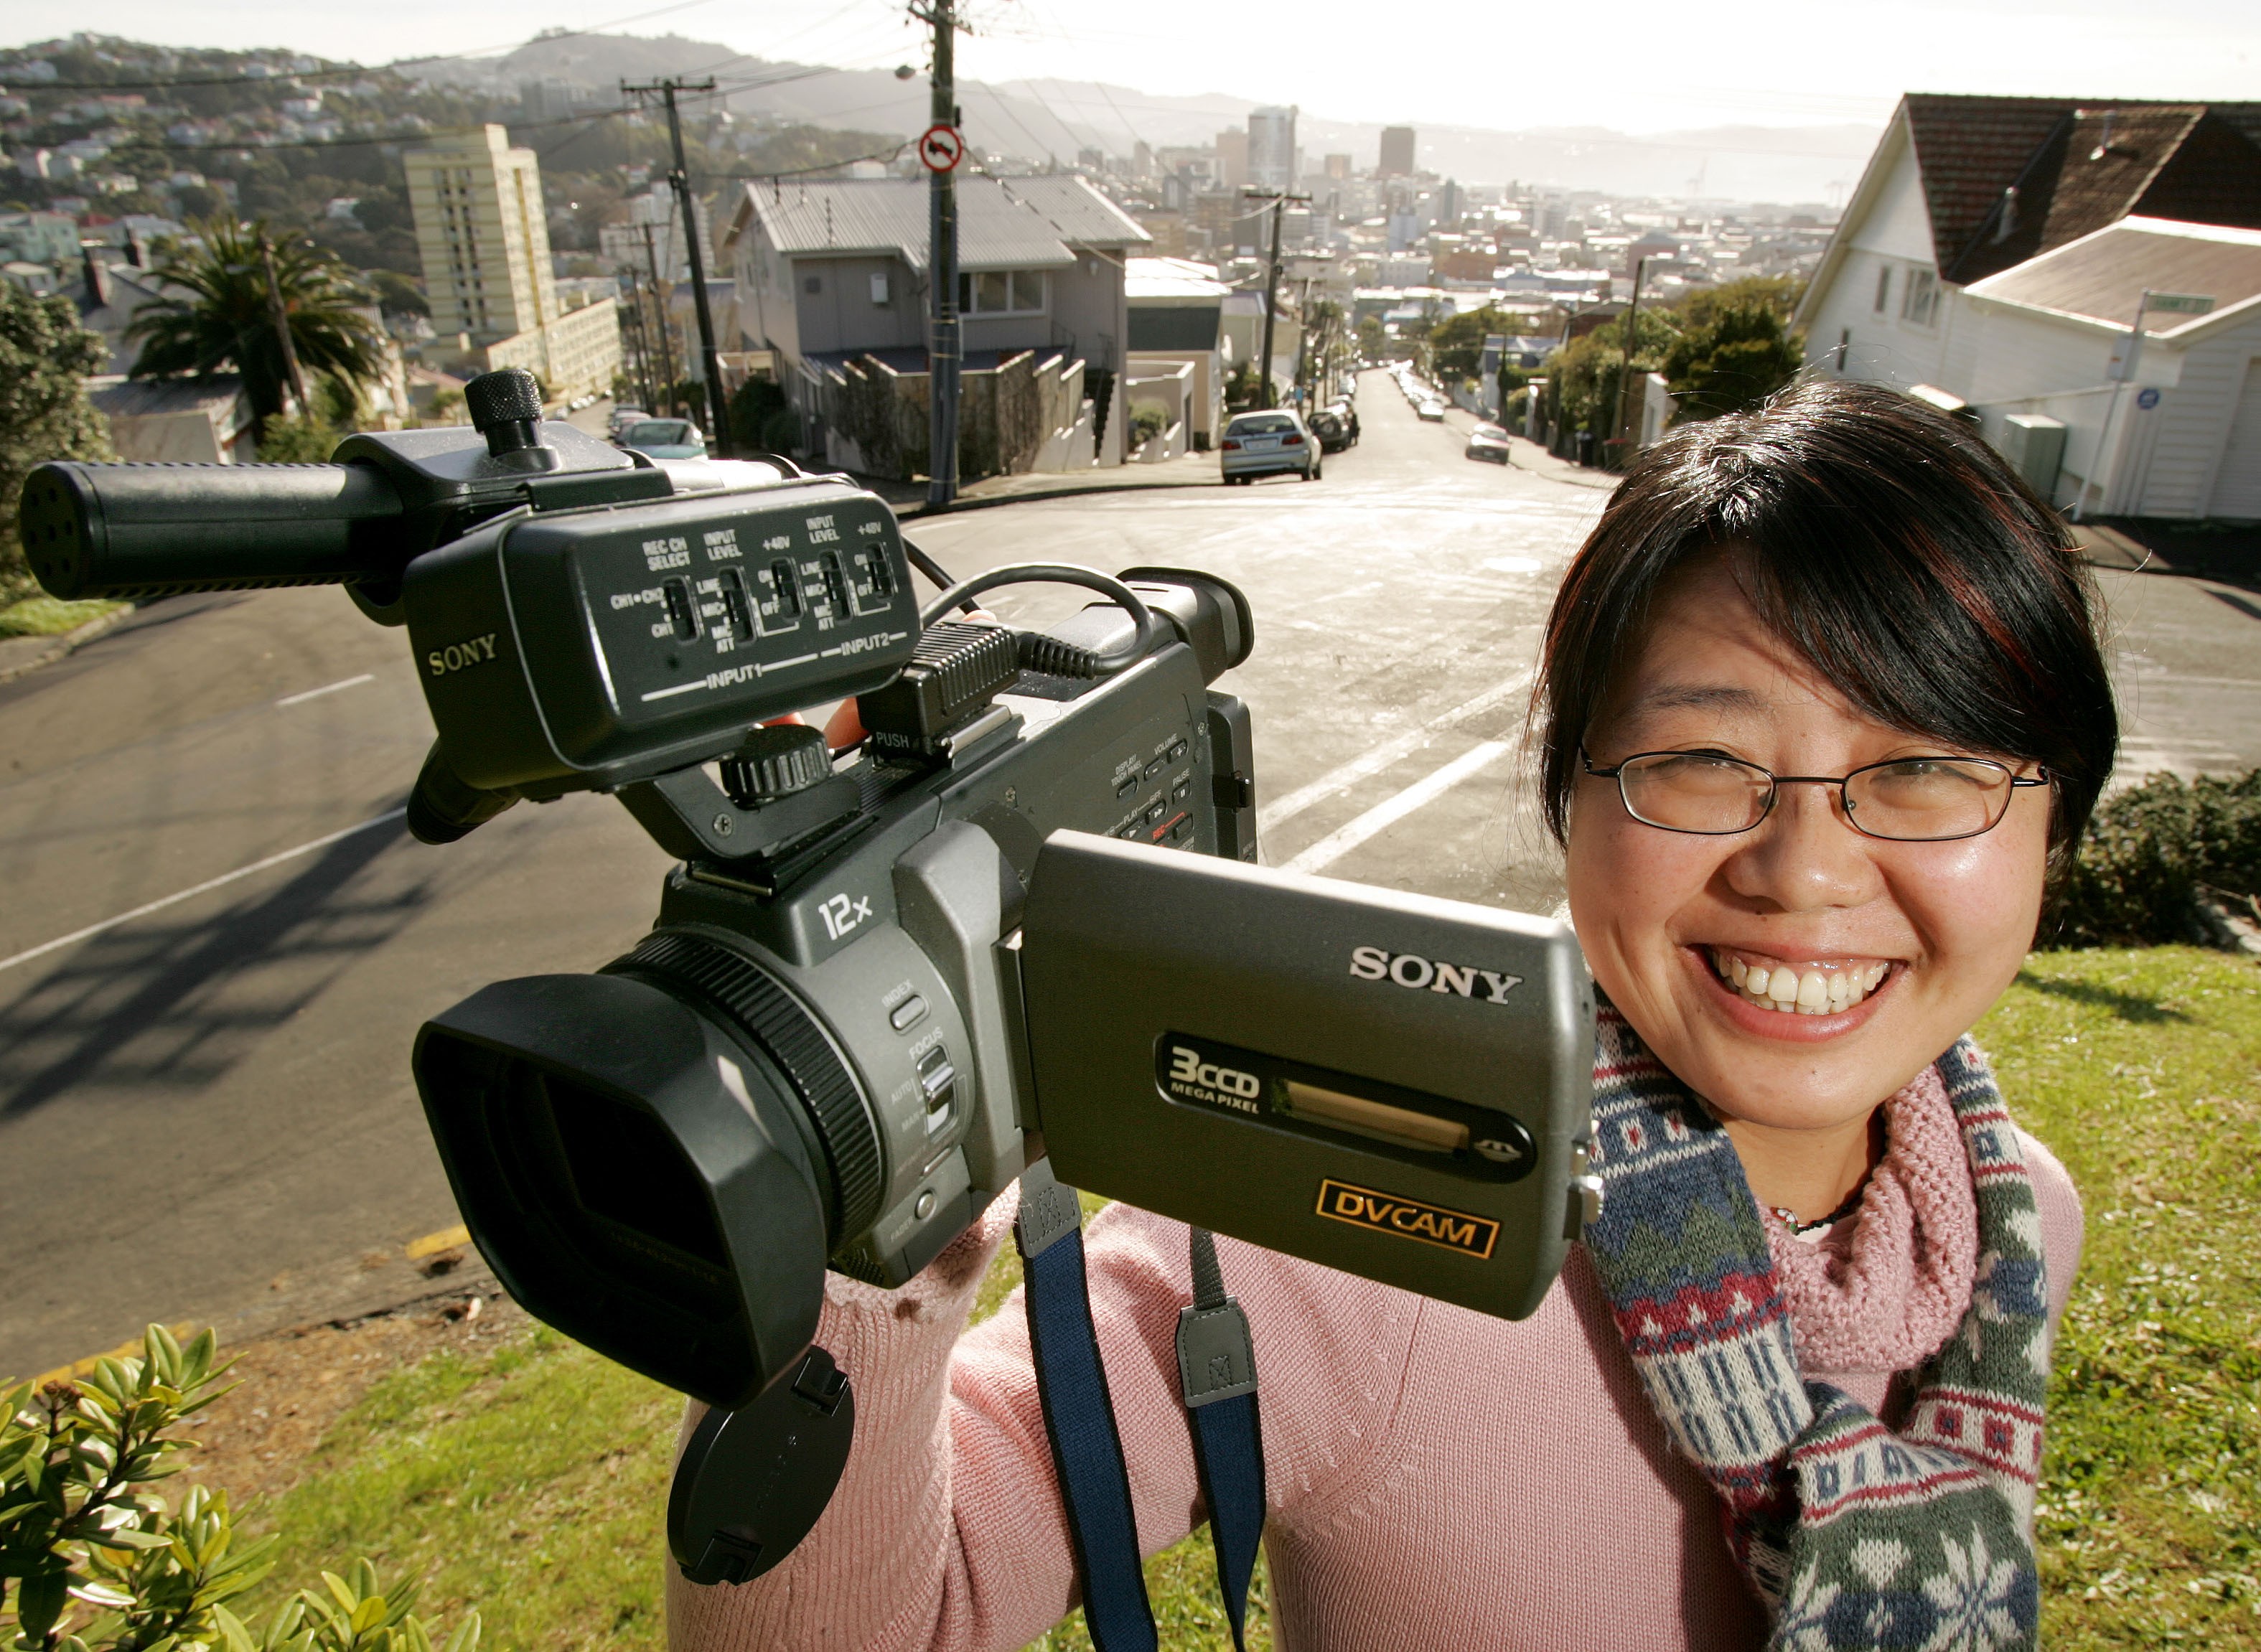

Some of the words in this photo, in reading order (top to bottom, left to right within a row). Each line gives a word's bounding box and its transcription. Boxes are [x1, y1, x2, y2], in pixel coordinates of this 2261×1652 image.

[806, 515, 835, 530] INPUT
[642, 540, 669, 556] REC
[668, 537, 688, 553] CH
[703, 529, 736, 546] INPUT
[809, 528, 841, 544] LEVEL
[647, 550, 691, 571] SELECT
[706, 543, 743, 560] LEVEL
[429, 633, 497, 676] SONY
[841, 632, 890, 656] INPUT2
[706, 662, 762, 690] INPUT1
[876, 731, 909, 748] PUSH
[1154, 733, 1178, 755] VOLUME
[1172, 768, 1190, 787] PAUSE
[1123, 807, 1138, 825] PLAY
[1153, 825, 1166, 840] REC
[1349, 946, 1523, 1005] SONY
[881, 979, 914, 1008] INDEX
[909, 1026, 943, 1060] FOCUS
[1169, 1045, 1260, 1099] 3CCD
[891, 1082, 912, 1105] AUTO
[1171, 1081, 1216, 1102] MEGA
[1217, 1094, 1260, 1114] PIXEL
[1335, 1191, 1477, 1247] DVCAM
